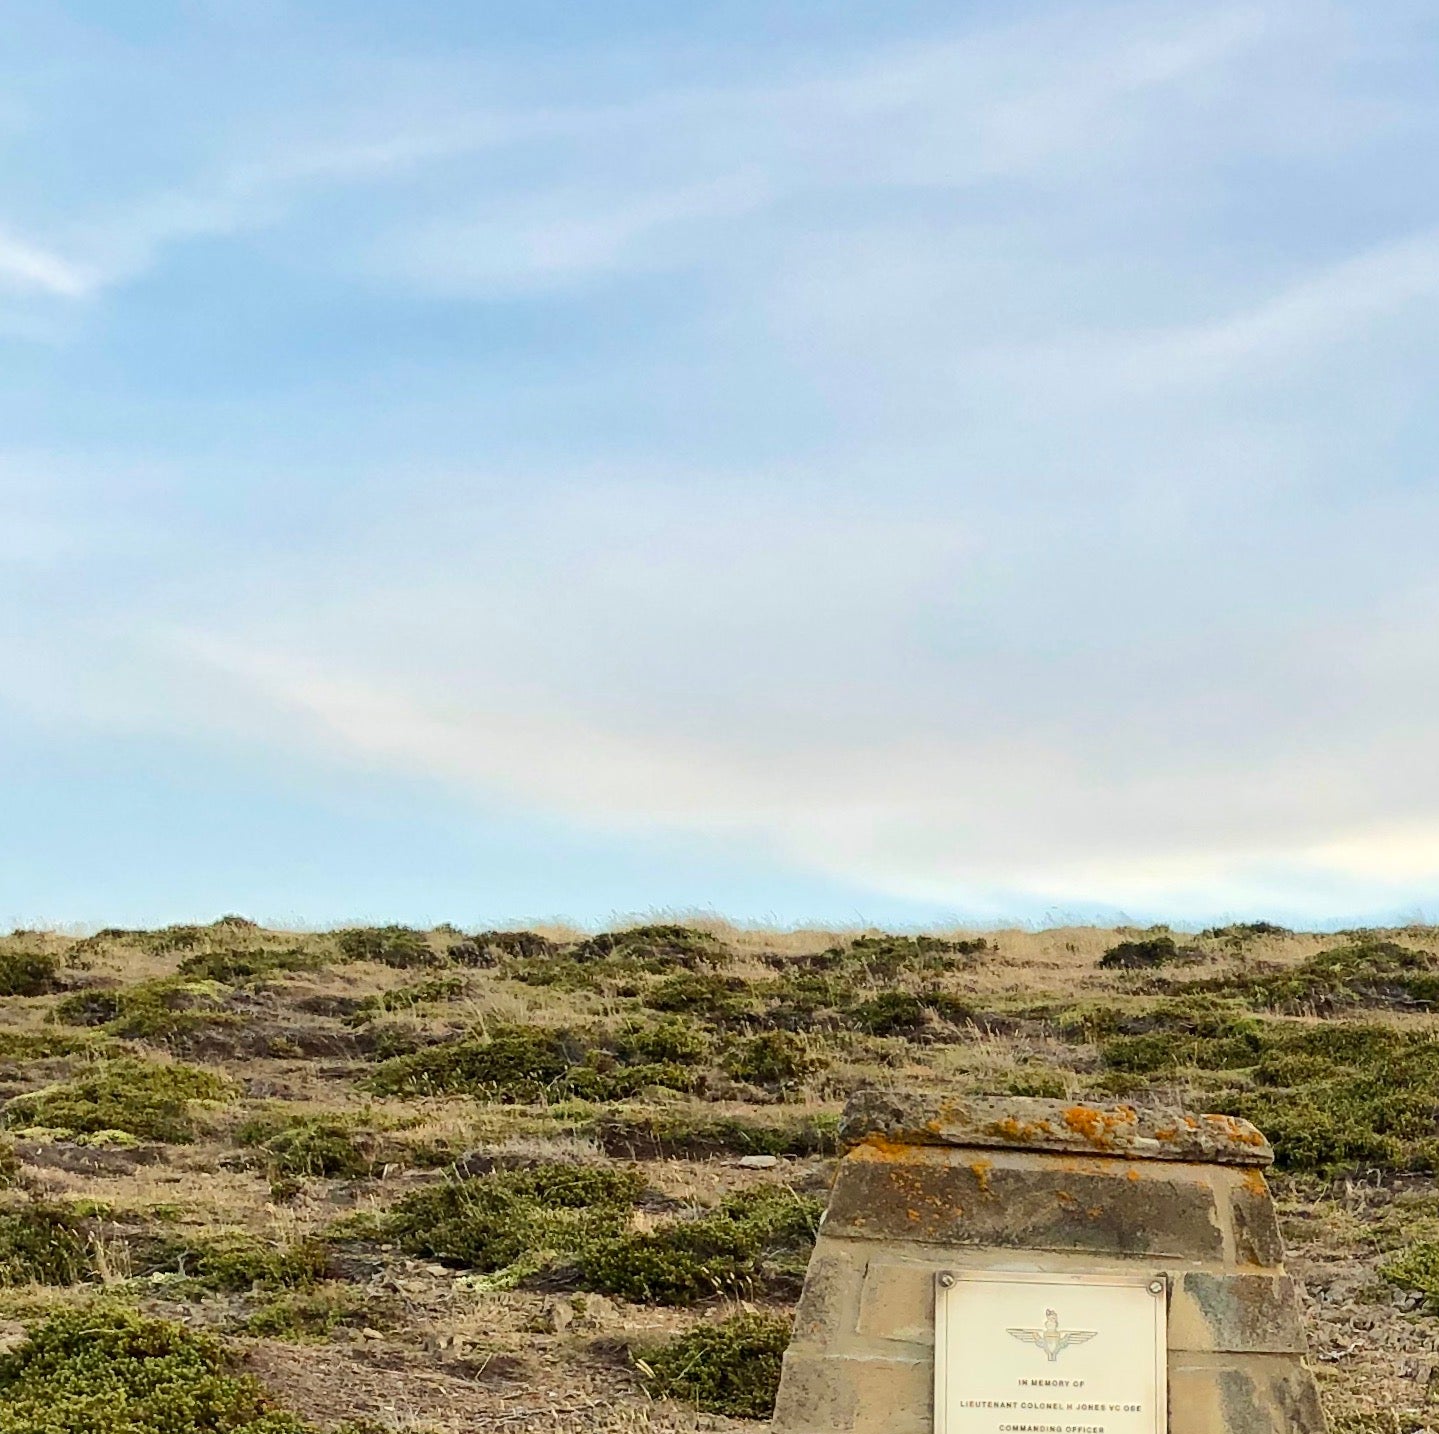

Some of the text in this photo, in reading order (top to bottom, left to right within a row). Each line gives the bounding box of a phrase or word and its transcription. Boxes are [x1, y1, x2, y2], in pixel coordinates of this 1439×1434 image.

[1031, 1379, 1069, 1387] MEMORY
[960, 1400, 1018, 1409] LIEUTENANT
[1020, 1402, 1064, 1410] COLONEL
[1076, 1403, 1106, 1411] JONES
[999, 1424, 1062, 1432] COMMANDING
